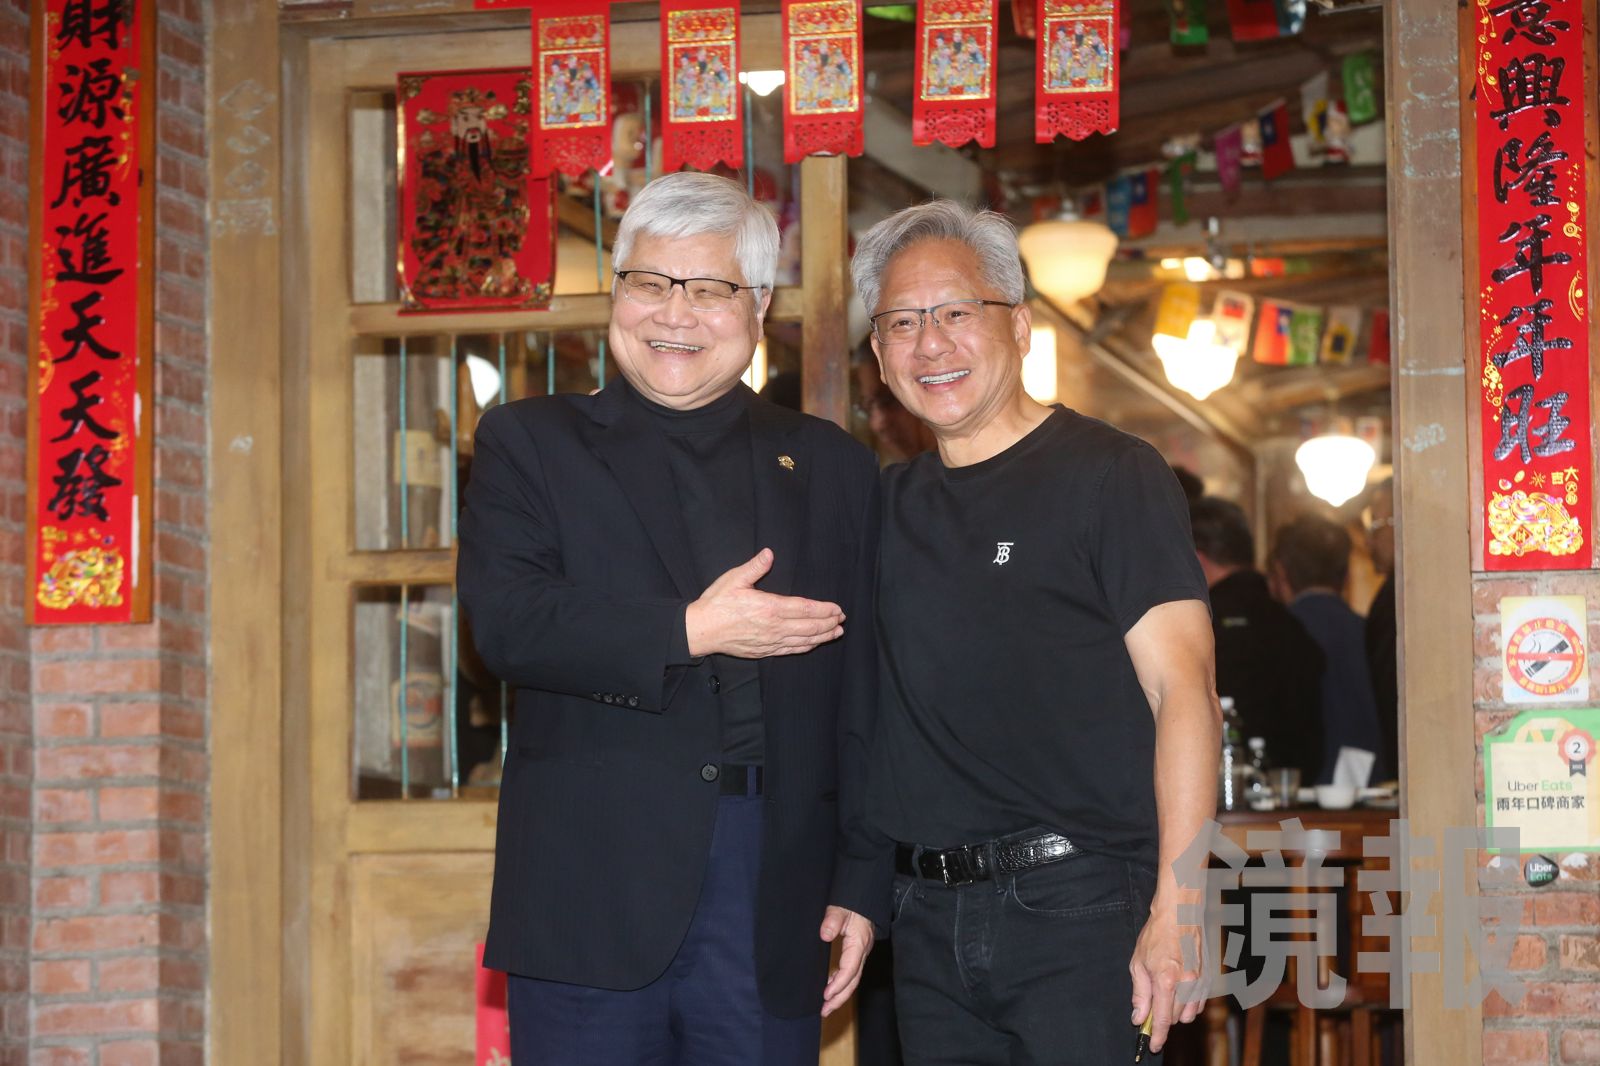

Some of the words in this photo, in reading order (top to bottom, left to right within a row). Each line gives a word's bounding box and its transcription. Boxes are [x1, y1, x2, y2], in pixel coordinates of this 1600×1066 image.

[1489, 0, 1577, 464] 意興隆年年旺
[48, 0, 126, 521] 財源廣進天天發
[1572, 741, 1581, 754] 2
[1507, 780, 1537, 792] Uber
[1541, 780, 1572, 791] Eats
[1496, 795, 1585, 811] 兩年口碑商家
[1529, 863, 1552, 872] Uber
